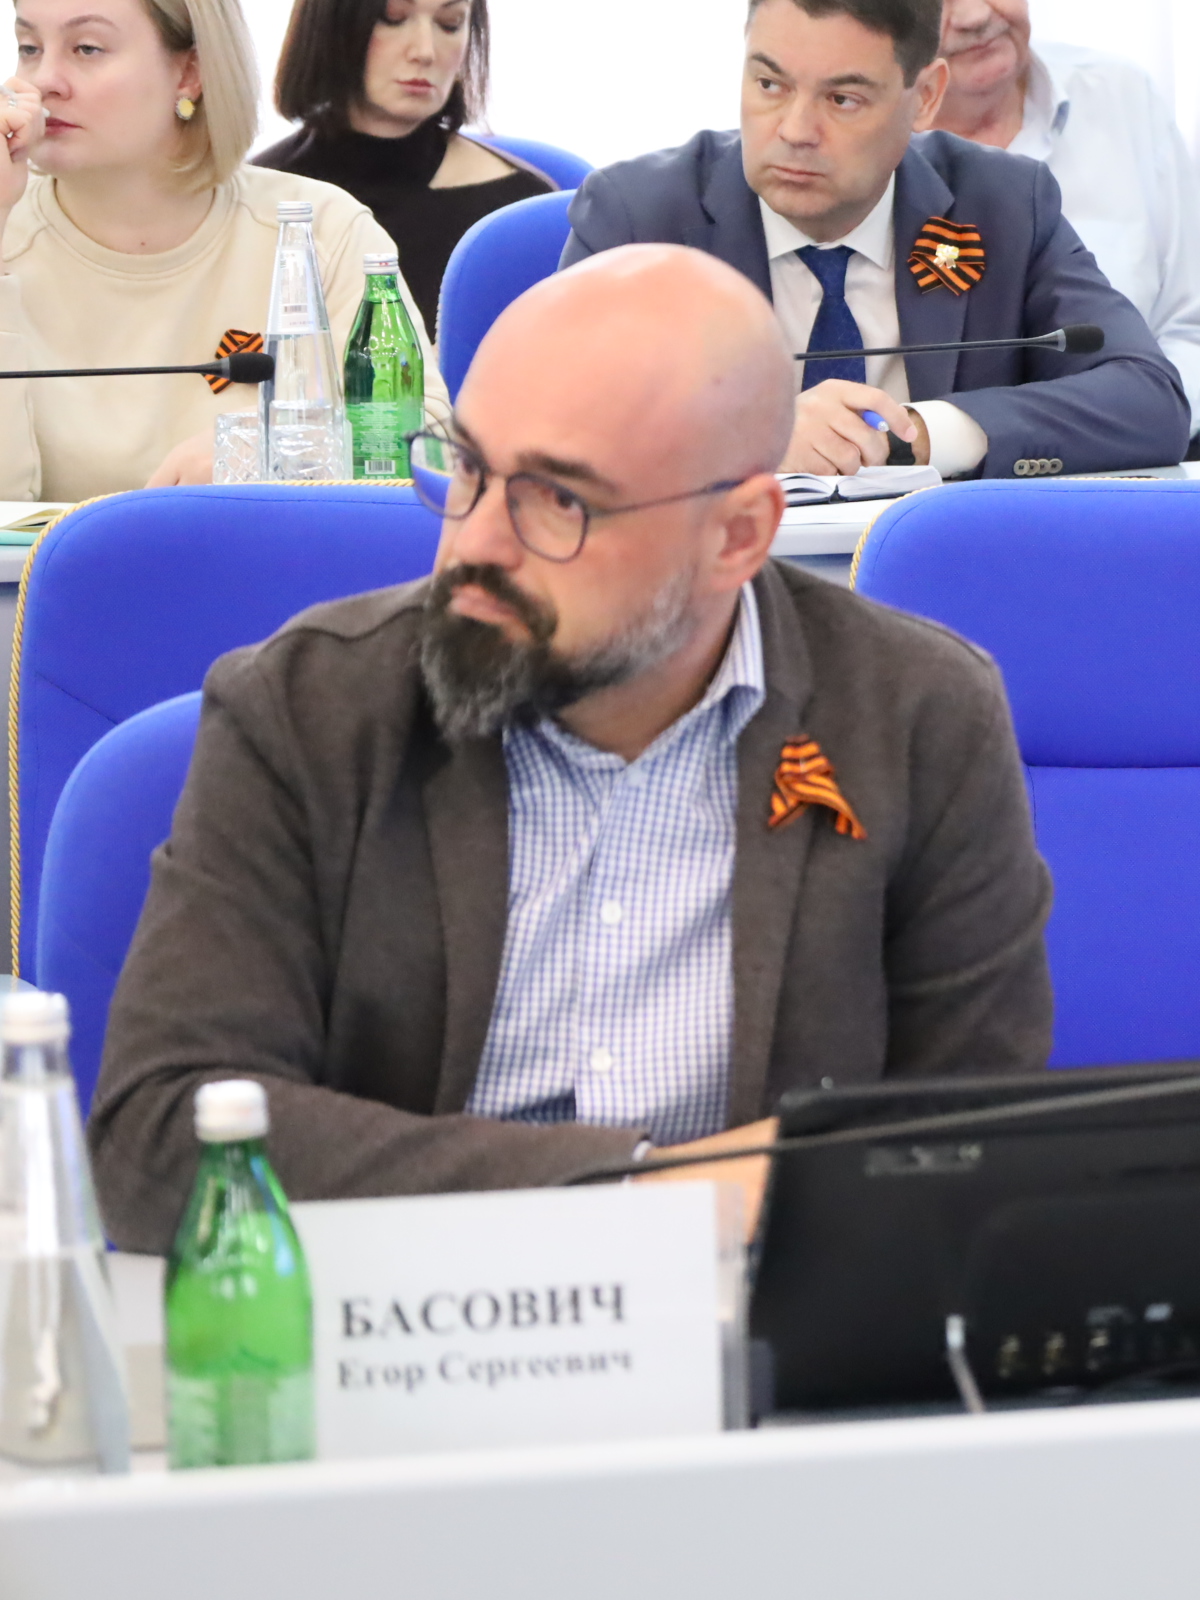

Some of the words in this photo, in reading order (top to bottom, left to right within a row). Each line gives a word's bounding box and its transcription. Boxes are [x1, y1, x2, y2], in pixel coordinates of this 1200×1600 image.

[340, 1283, 626, 1340] БАСОВИЧ
[337, 1358, 425, 1393] Егор
[438, 1350, 632, 1388] Сергеевич
